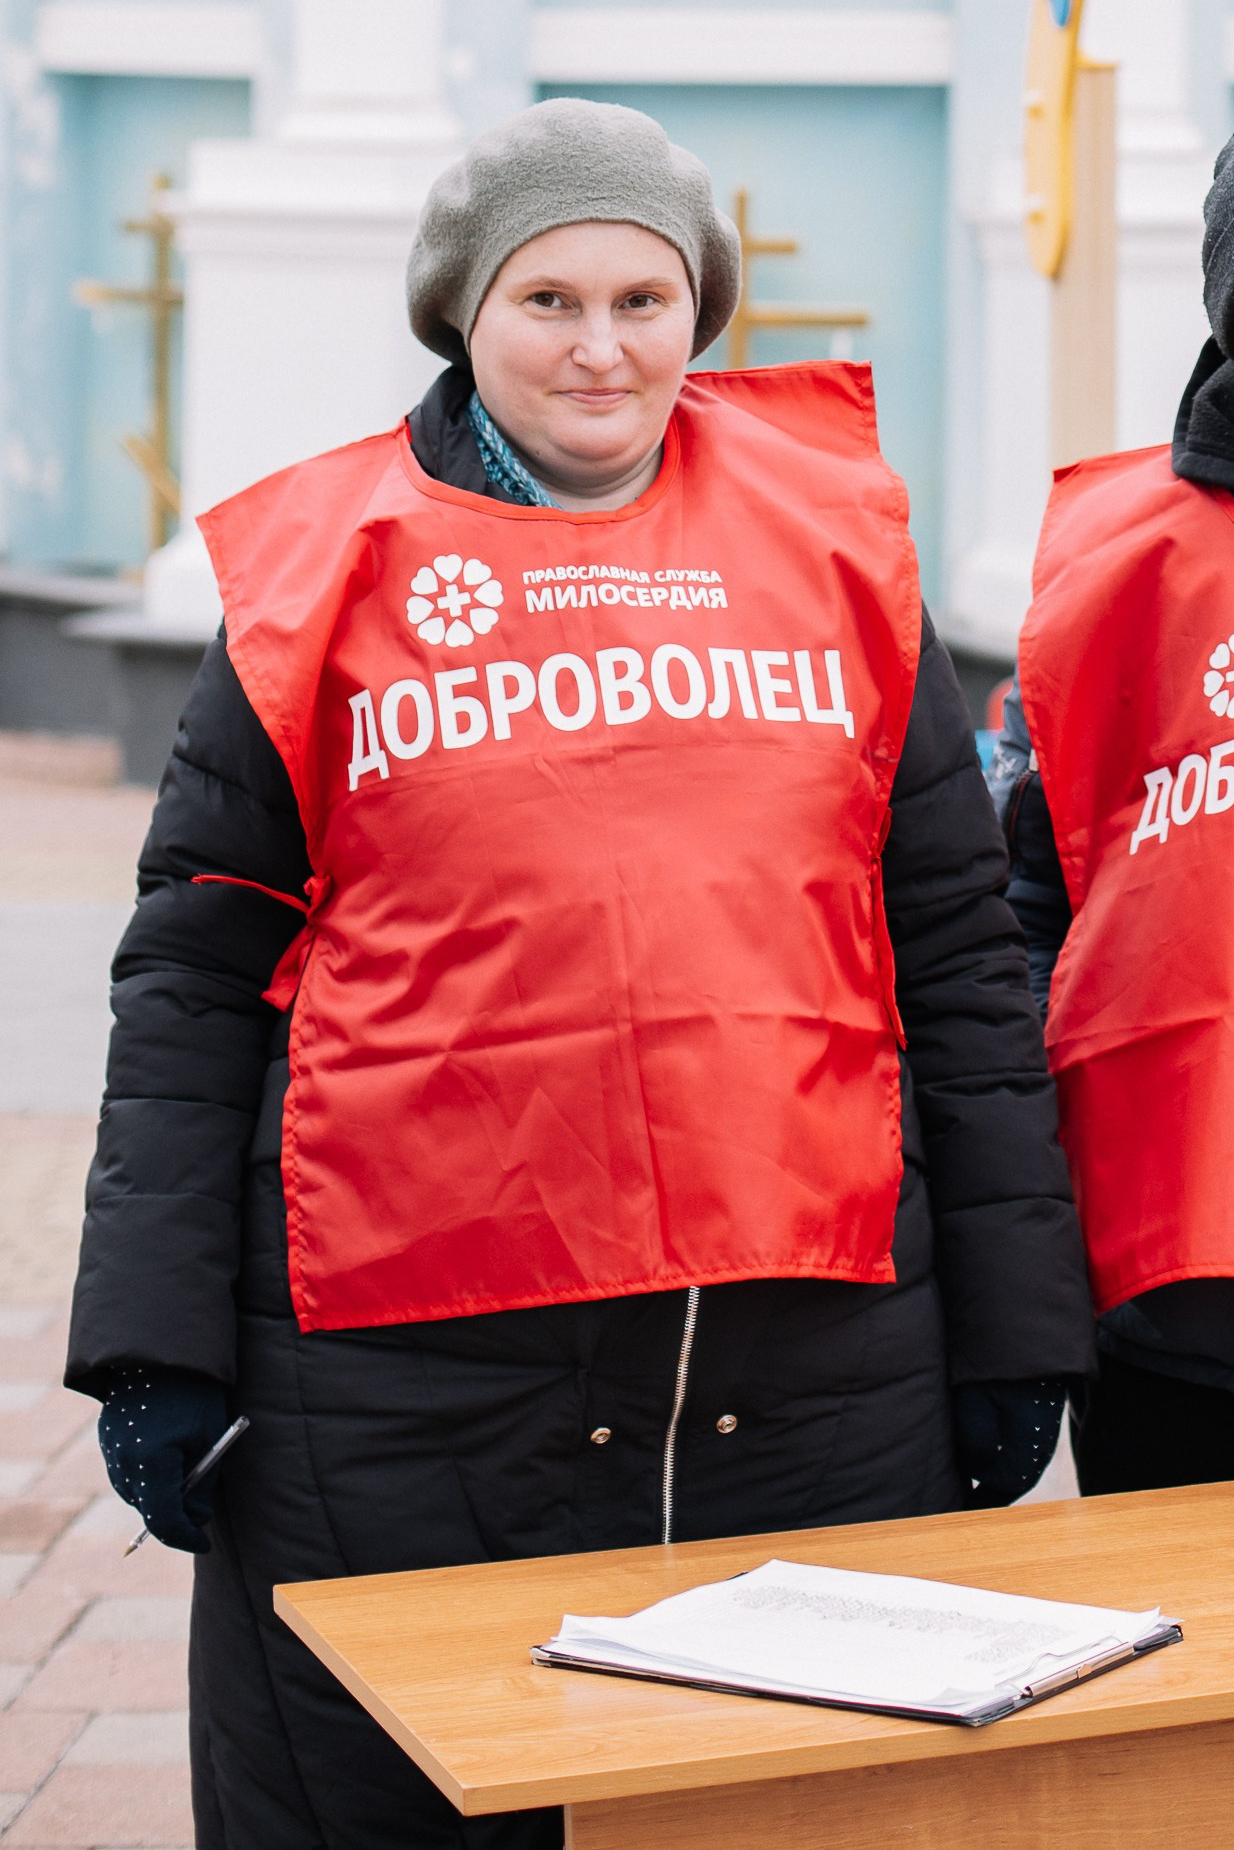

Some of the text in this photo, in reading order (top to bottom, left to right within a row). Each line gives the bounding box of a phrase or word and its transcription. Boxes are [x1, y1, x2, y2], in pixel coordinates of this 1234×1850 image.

[522, 564, 723, 584] ПРАВОСЛАВНАЯ СЛУЖБА
[525, 583, 728, 613] МИЛОСЕРДИЯ
[347, 643, 855, 792] ДОБРОВОЛЕЦ
